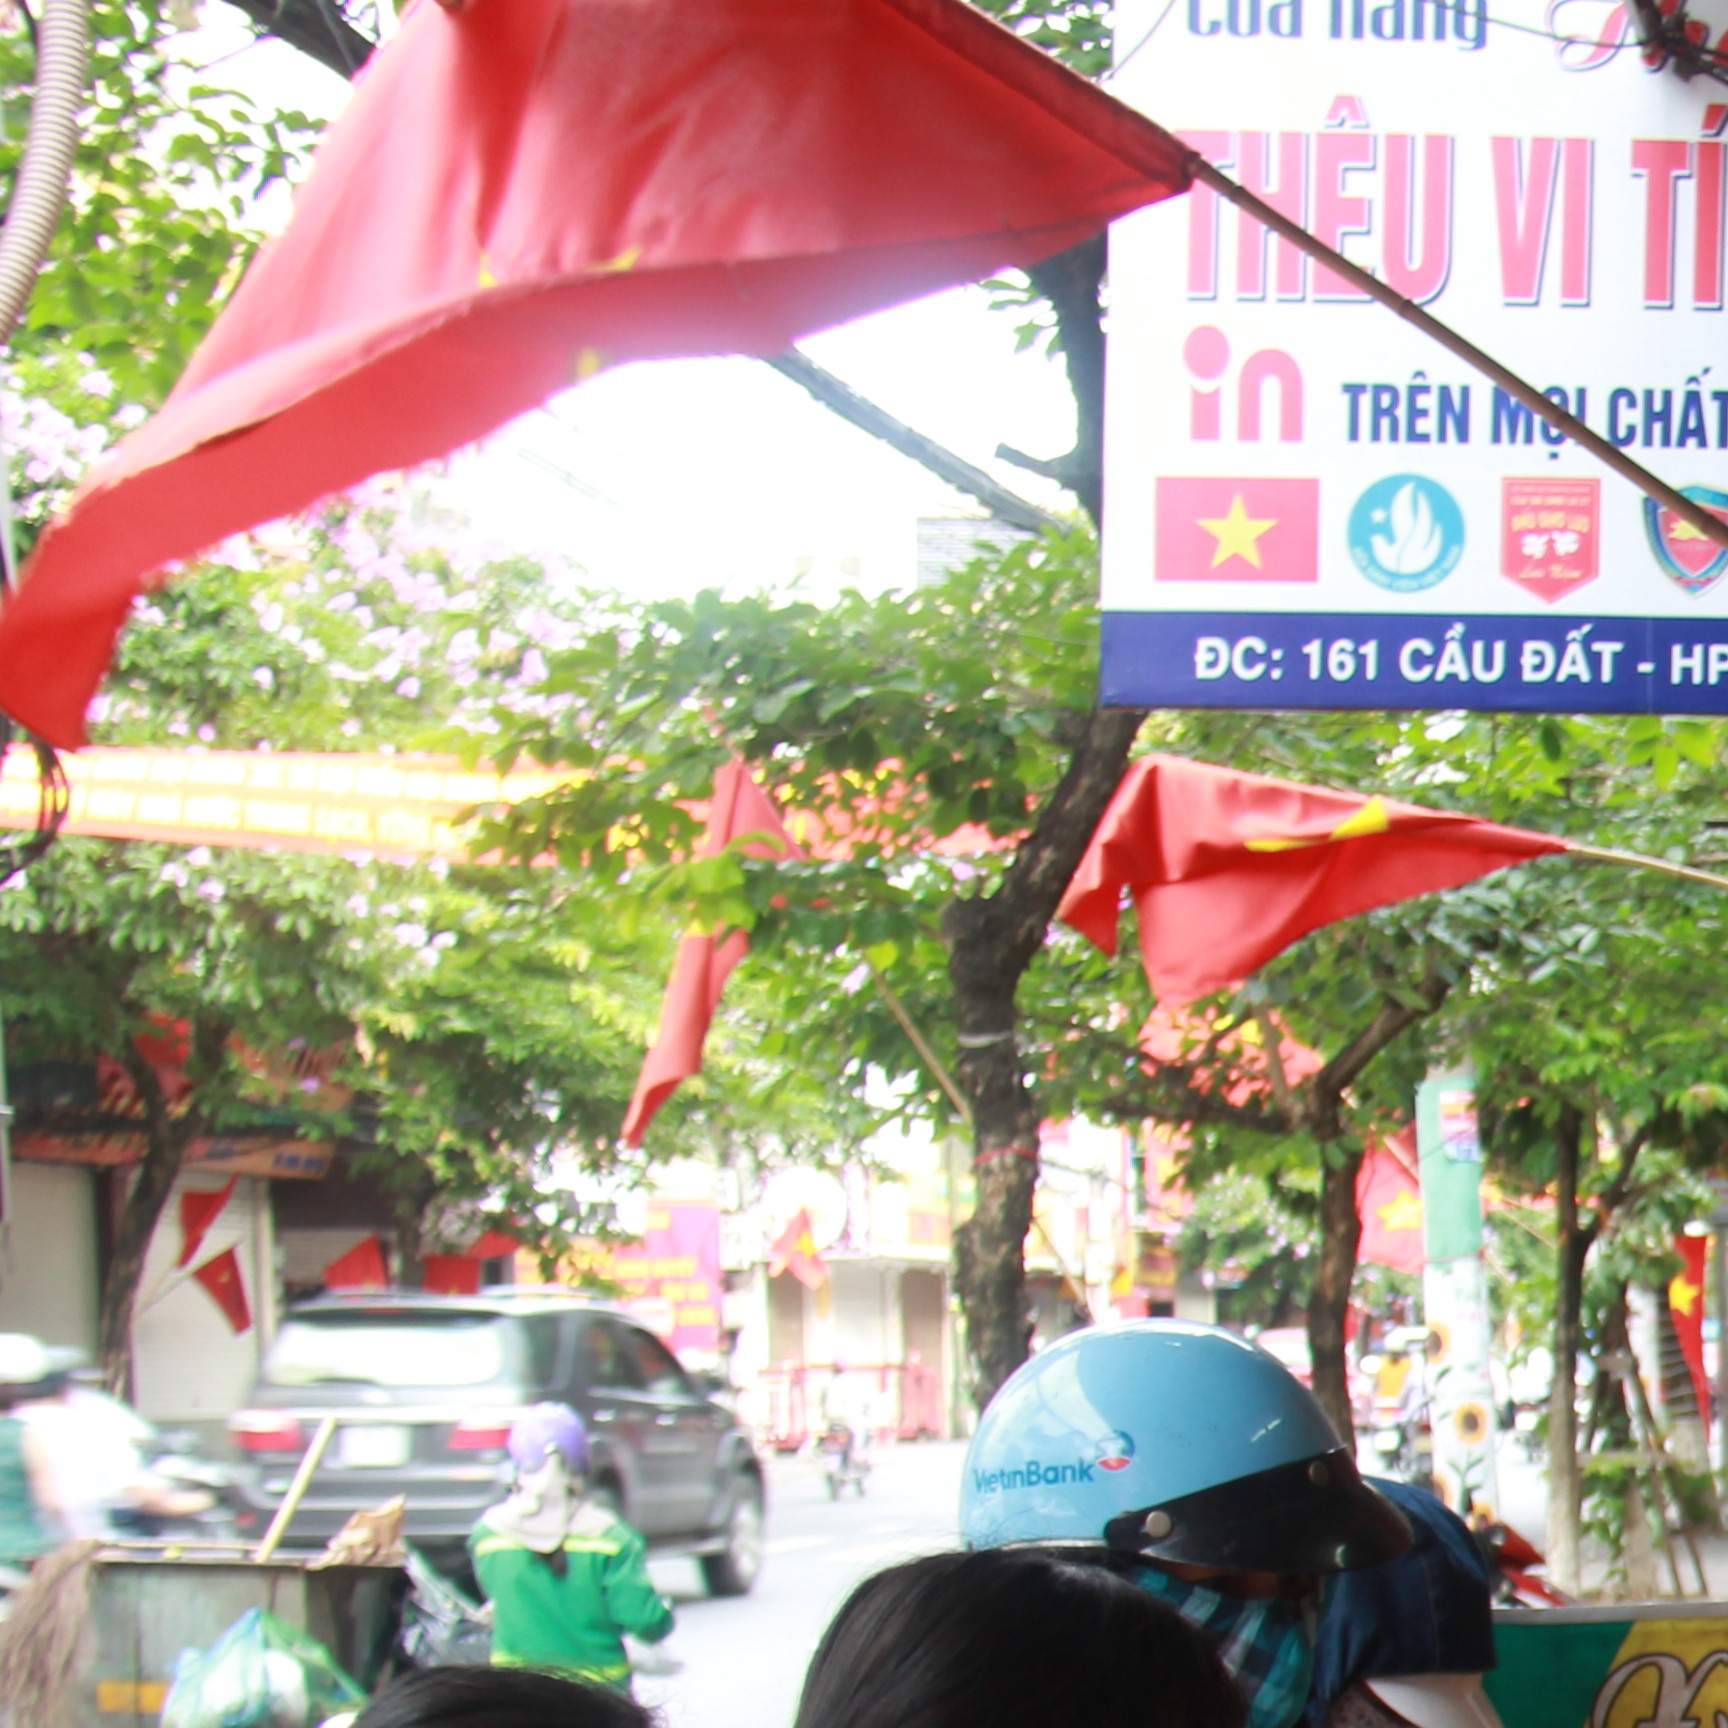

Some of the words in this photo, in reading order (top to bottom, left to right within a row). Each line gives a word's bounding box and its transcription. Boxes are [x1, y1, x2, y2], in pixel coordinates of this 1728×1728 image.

[1178, 94, 1455, 304] THÊU
[1490, 136, 1597, 307] VI
[1182, 324, 1306, 443] in
[1341, 371, 1472, 445] TRÊN
[1194, 636, 1285, 683] ĐC:
[1301, 637, 1381, 682] 161
[1520, 623, 1624, 684] ĐẤT
